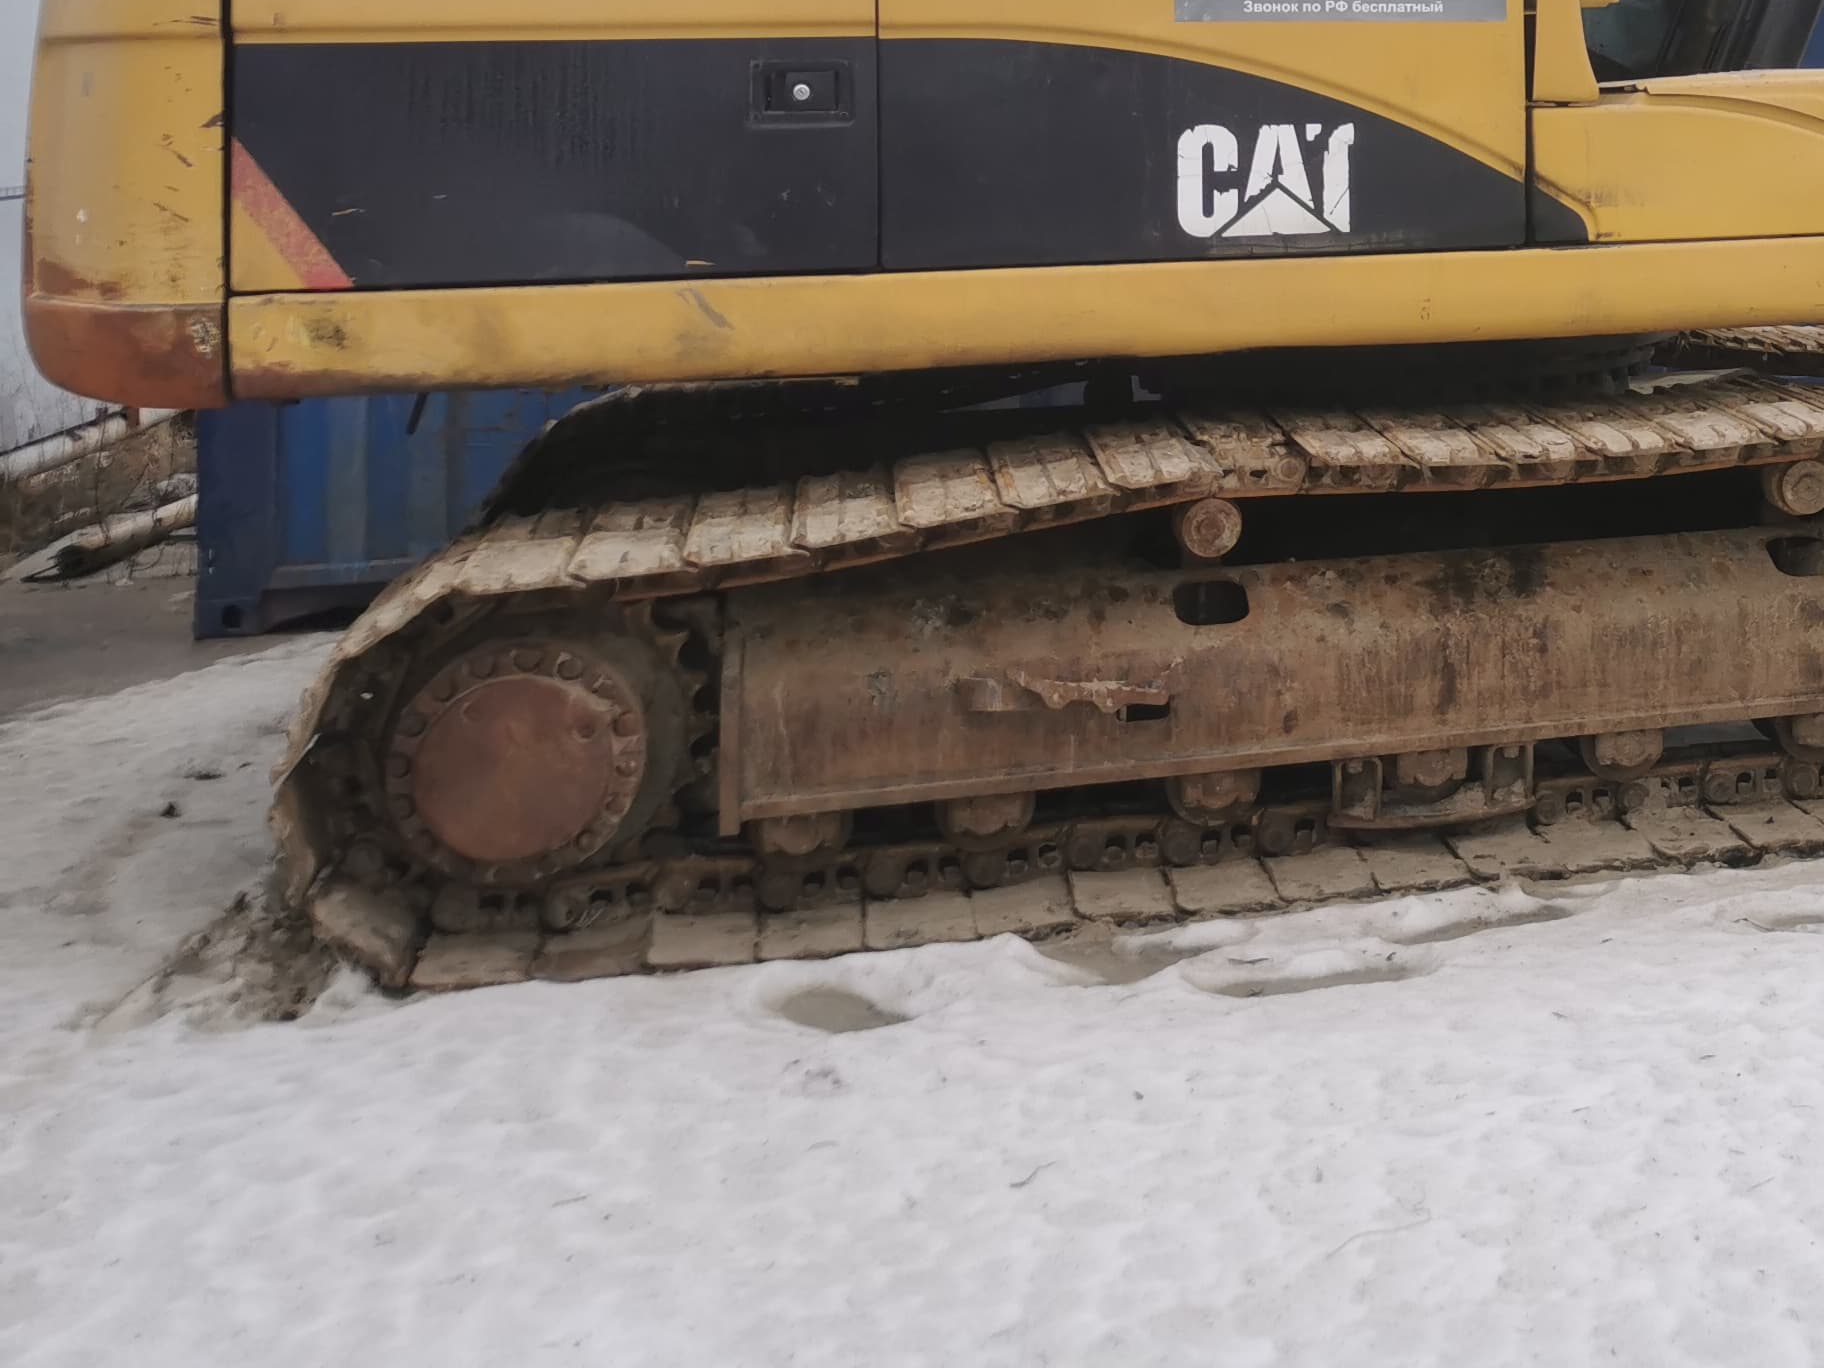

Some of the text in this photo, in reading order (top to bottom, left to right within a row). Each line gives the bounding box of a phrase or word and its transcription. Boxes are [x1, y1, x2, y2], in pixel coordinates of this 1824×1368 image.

[1243, 0, 1444, 14] Звонок по РФ бесплатный
[1177, 122, 1354, 237] CAT
